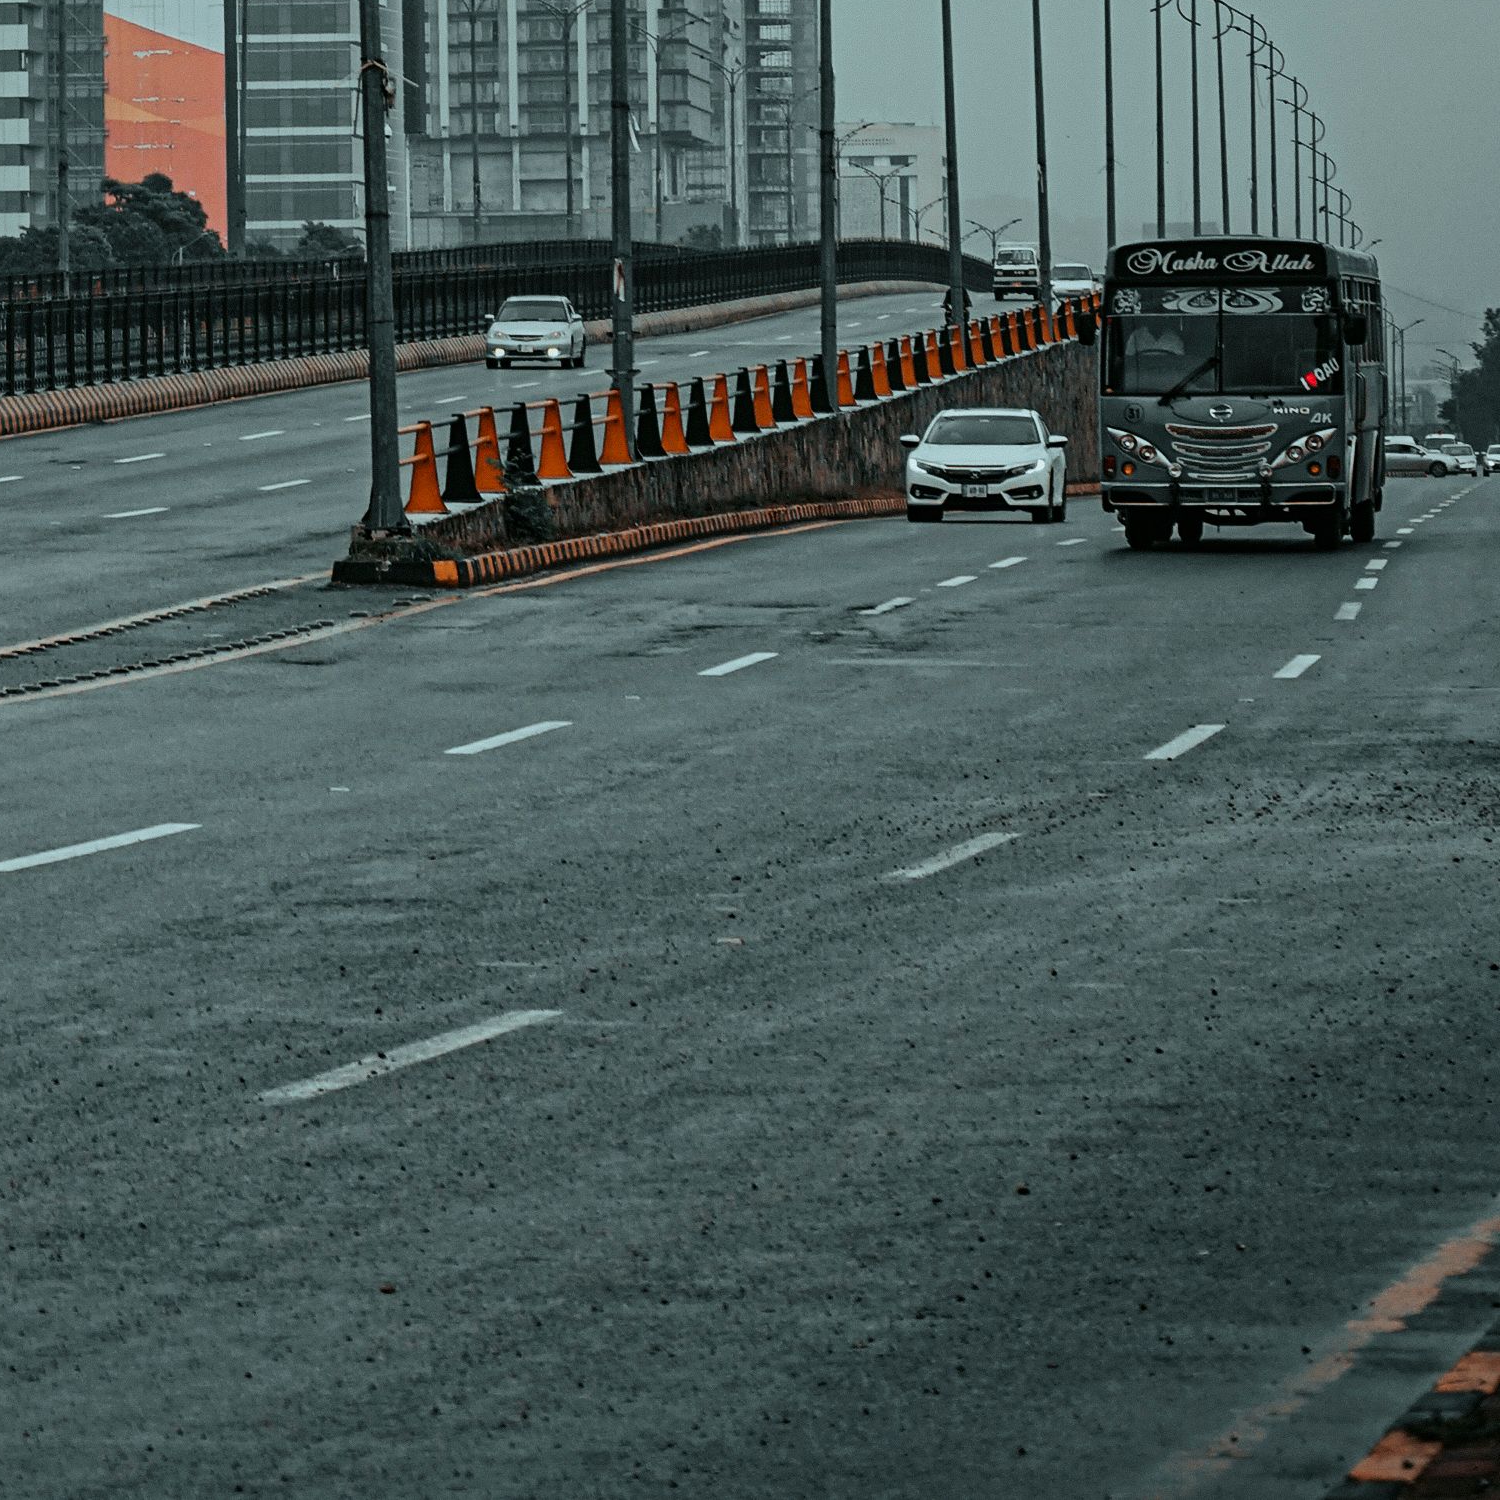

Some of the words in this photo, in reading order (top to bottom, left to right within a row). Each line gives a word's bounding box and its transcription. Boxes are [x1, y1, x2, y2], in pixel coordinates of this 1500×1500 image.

[1127, 248, 1219, 275] Masha
[1223, 249, 1316, 273] Allah
[1273, 407, 1310, 415] HINO
